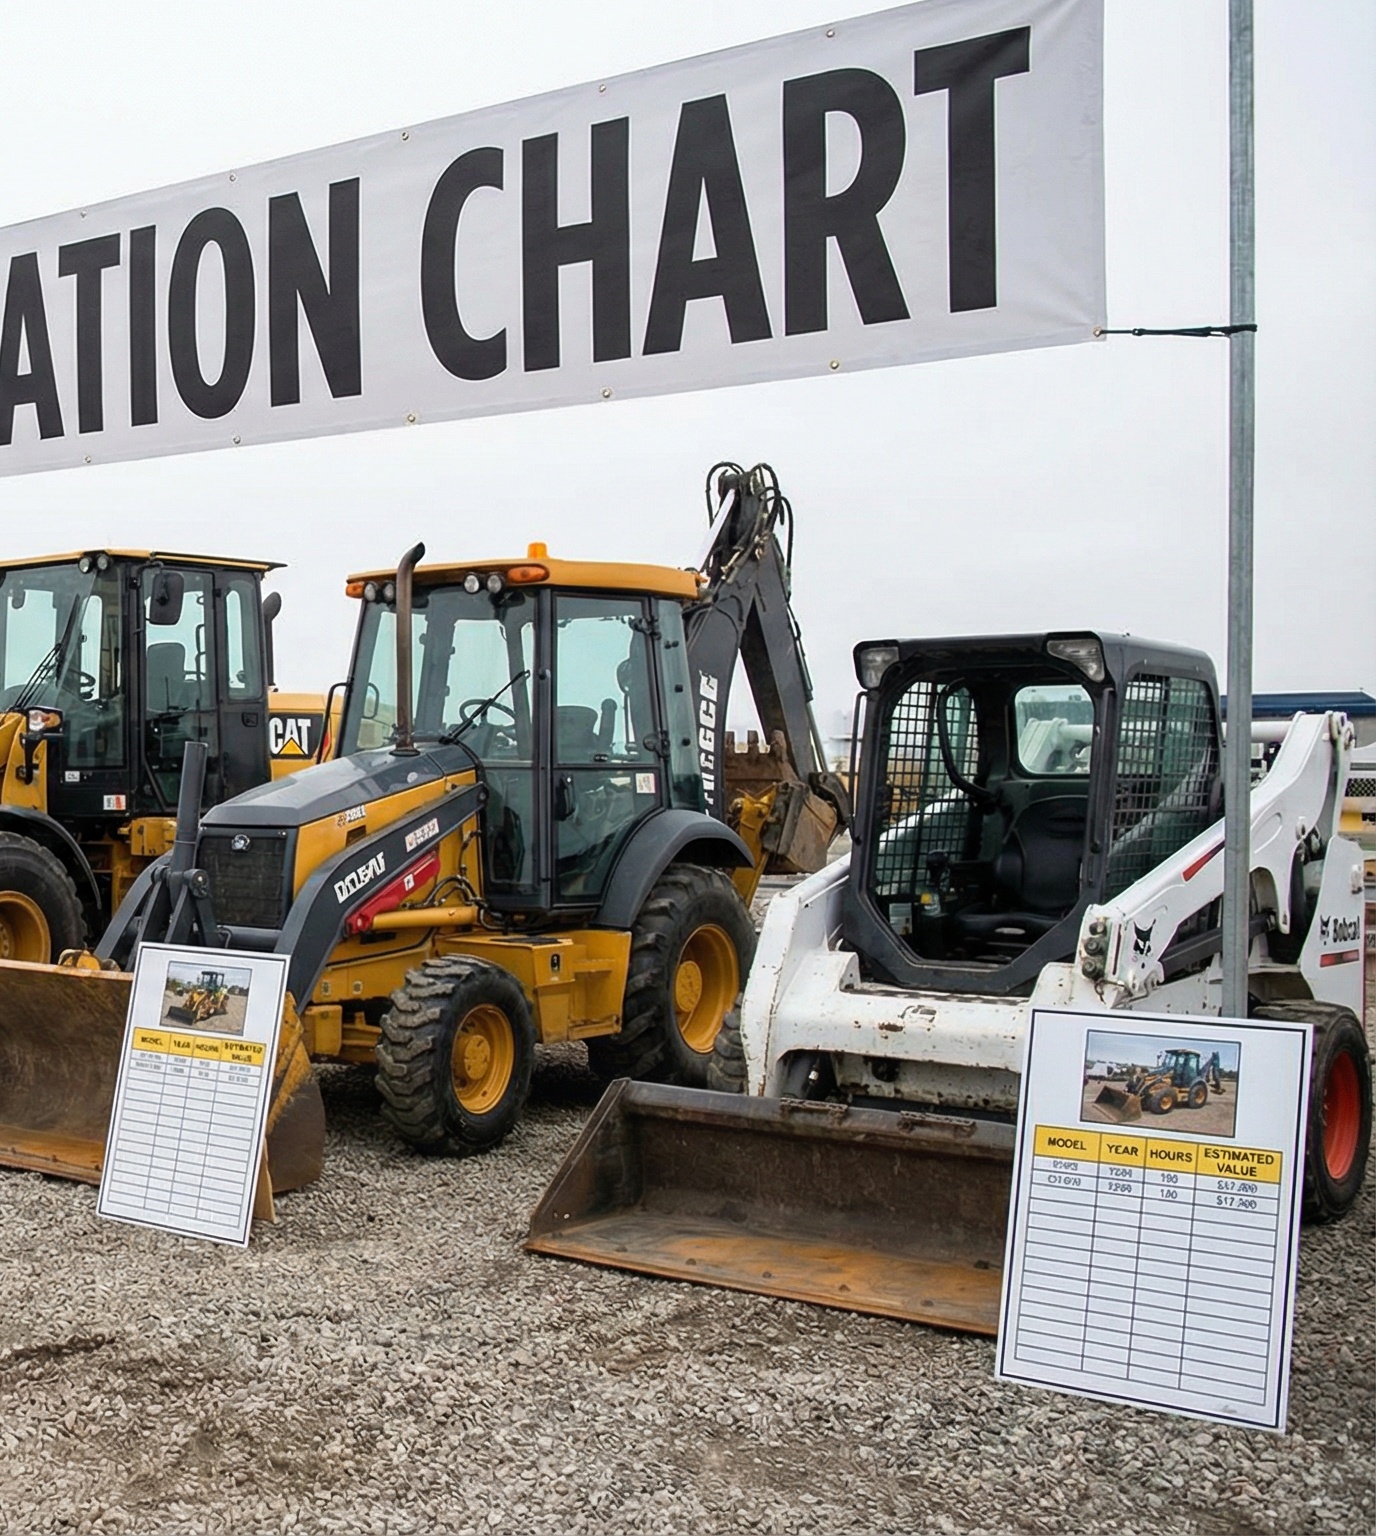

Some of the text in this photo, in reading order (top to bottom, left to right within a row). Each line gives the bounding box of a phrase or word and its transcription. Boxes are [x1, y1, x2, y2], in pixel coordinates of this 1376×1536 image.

[421, 25, 1030, 381] CHART
[269, 717, 311, 755] CAT
[1106, 1144, 1139, 1157] YEAR
[1150, 1149, 1193, 1163] HOURS
[1217, 1163, 1257, 1177] VALUE
